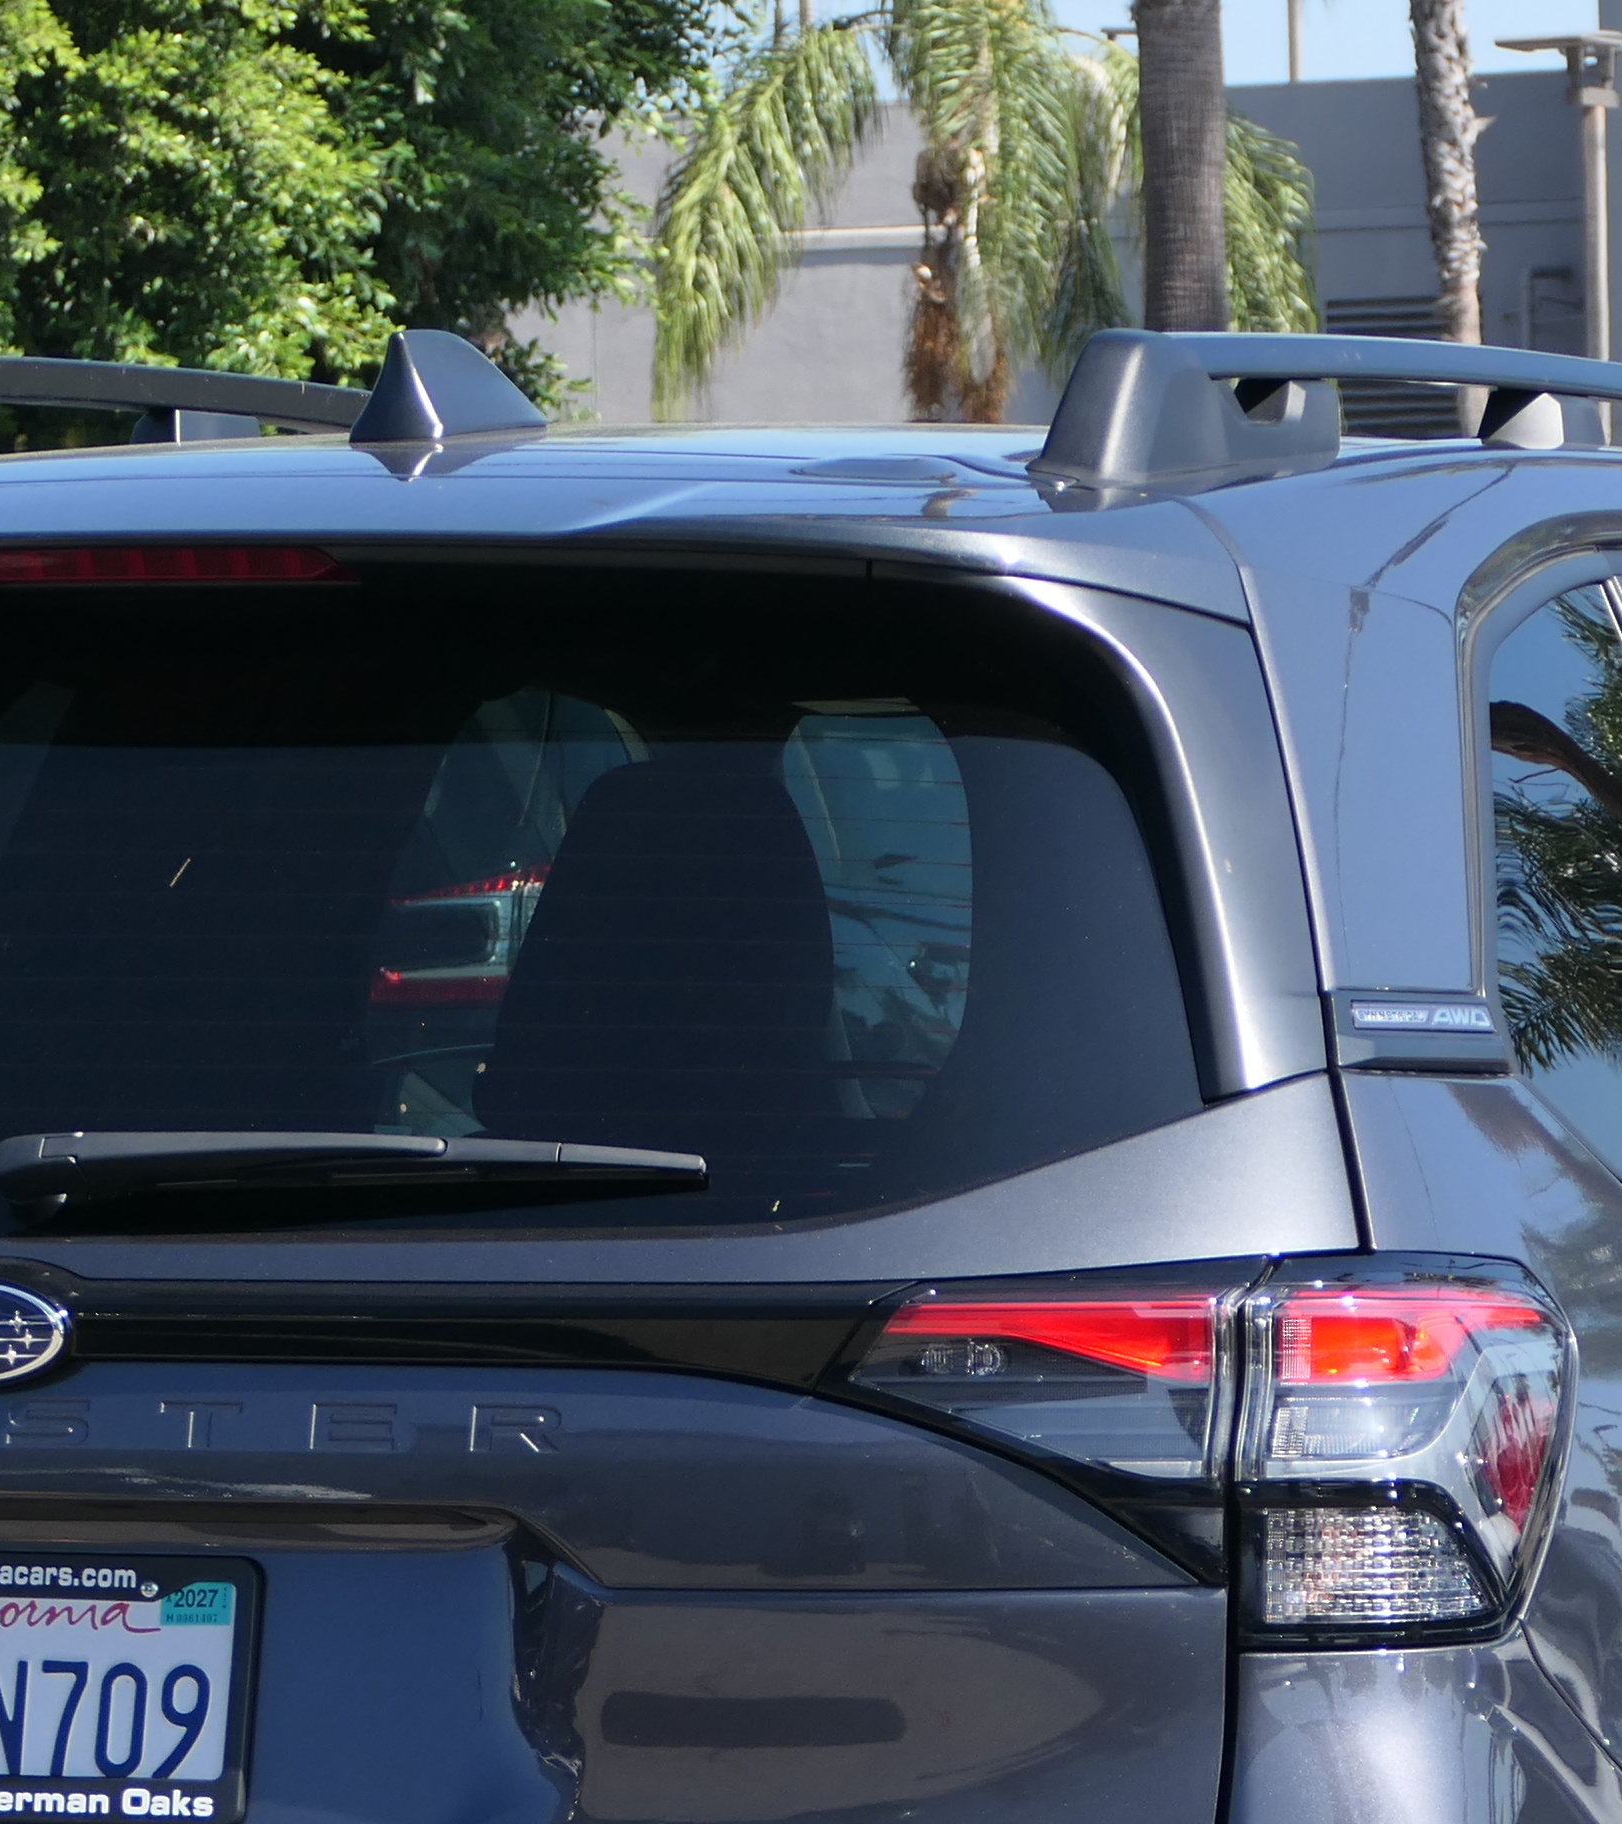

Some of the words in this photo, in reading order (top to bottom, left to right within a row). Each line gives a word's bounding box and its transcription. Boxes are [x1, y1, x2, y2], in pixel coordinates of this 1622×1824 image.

[1432, 1007, 1491, 1027] AWD
[173, 1588, 219, 1609] 2027
[121, 1787, 214, 1818] Oaks
